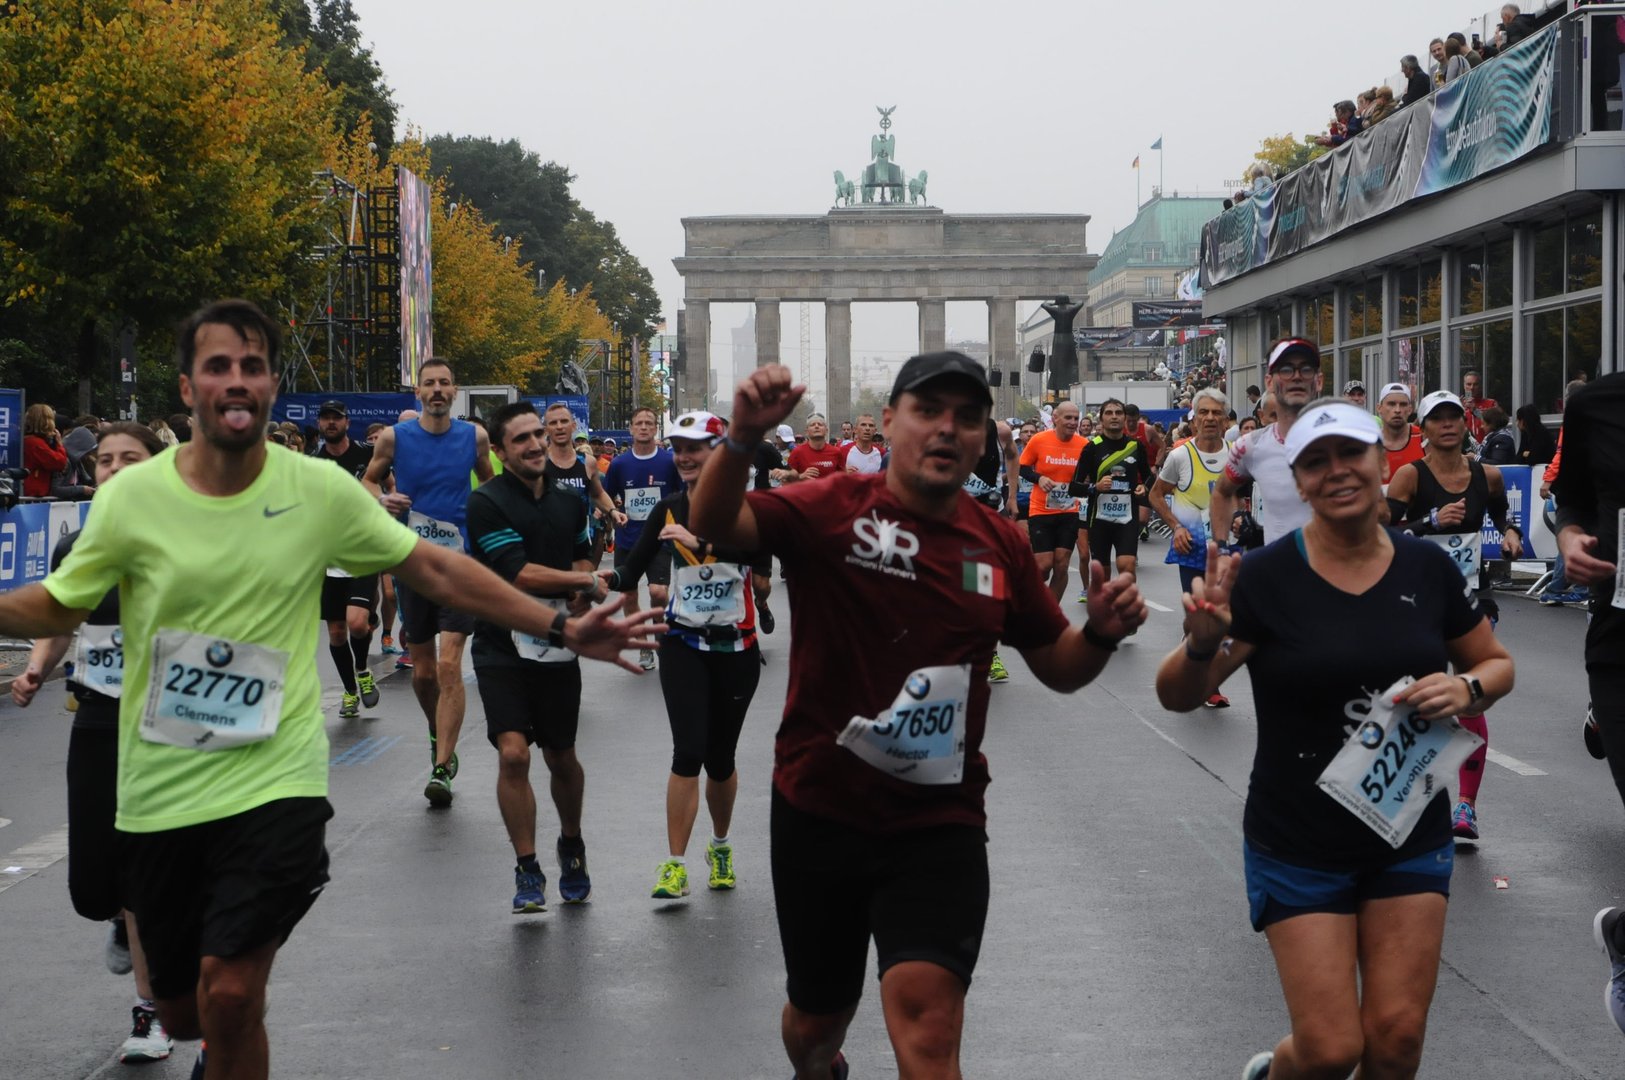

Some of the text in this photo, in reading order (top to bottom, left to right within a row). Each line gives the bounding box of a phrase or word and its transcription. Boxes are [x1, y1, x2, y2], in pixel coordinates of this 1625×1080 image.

[346, 408, 385, 416] ARATHON
[630, 496, 656, 507] 18450
[1102, 502, 1127, 512] 16881
[682, 580, 735, 602] 32567
[695, 604, 721, 613] Susan
[87, 648, 124, 669] 361
[165, 663, 265, 707] 22770
[174, 704, 237, 727] Clemens
[885, 747, 930, 760] Hector
[1360, 710, 1431, 805] 52246
[1393, 747, 1438, 803] Veronica
